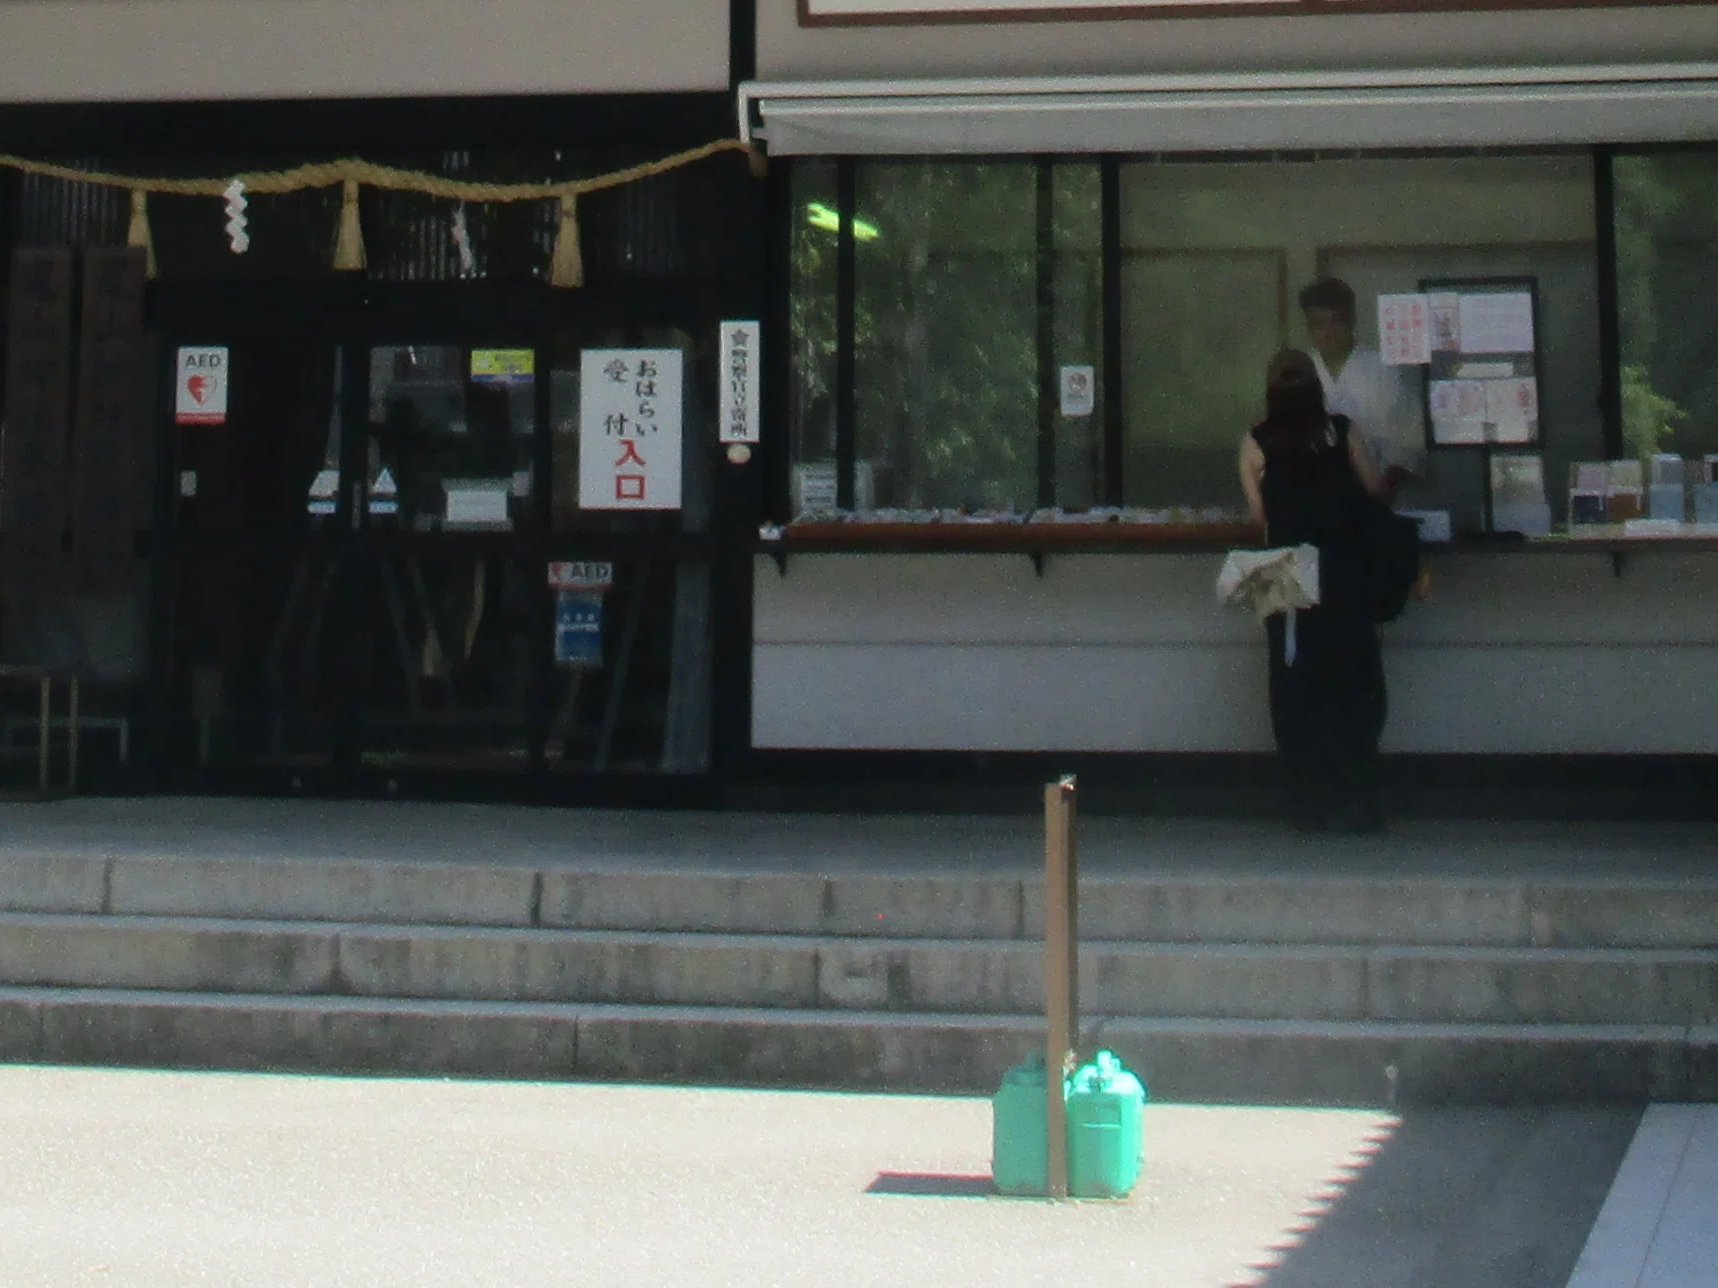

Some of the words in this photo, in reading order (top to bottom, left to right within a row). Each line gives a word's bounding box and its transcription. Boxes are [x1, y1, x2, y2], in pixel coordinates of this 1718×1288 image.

[185, 353, 221, 367] AED
[603, 358, 629, 435] 受付
[635, 358, 659, 438] おはらい
[614, 439, 646, 500] 入口
[571, 562, 608, 578] AED
